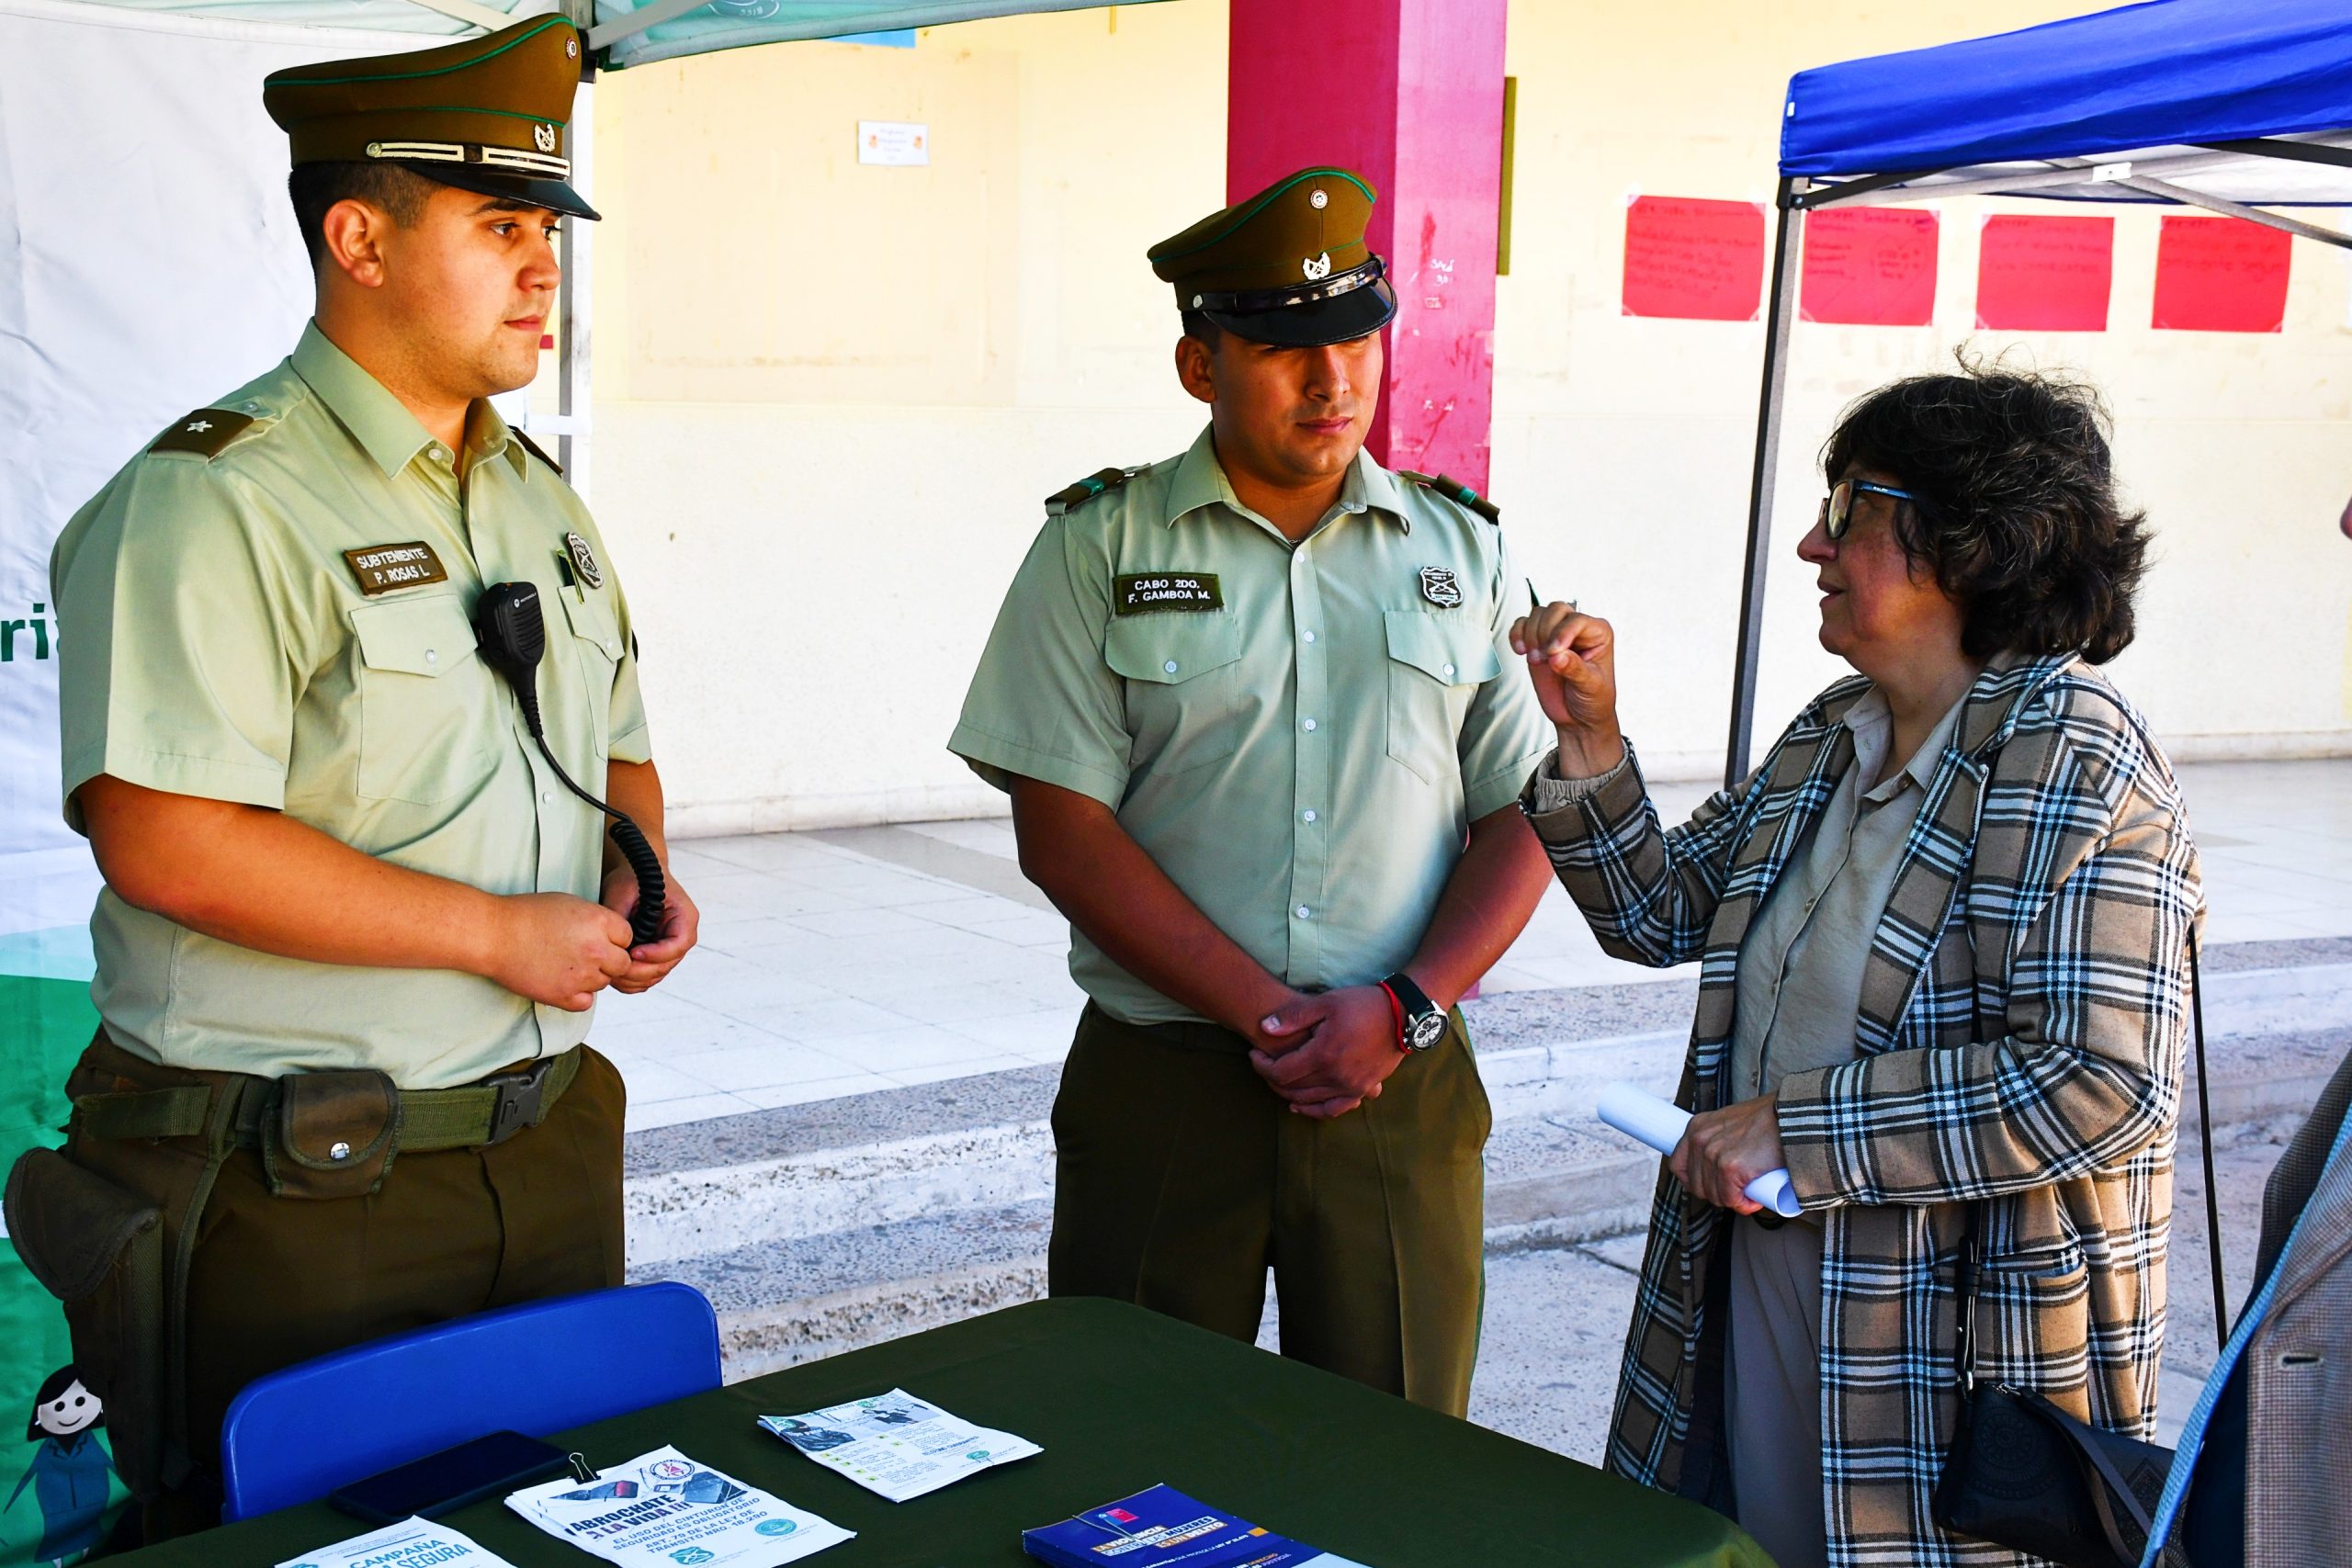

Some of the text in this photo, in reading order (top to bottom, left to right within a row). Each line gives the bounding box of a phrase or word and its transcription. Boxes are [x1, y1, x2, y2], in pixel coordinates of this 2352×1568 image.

[356, 548, 428, 569] SUBTENIENTE
[374, 572, 387, 584] P.
[386, 566, 419, 581] ROSAS
[1135, 579, 1200, 591] CABO 2DO.
[1128, 590, 1211, 604] F. GAMBOA M.
[0, 603, 59, 662] ri
[570, 1495, 676, 1531] ABROCHATE
[600, 1522, 629, 1535] LA
[623, 1508, 673, 1526] VIDA
[613, 1497, 760, 1550] SEGURIDAD ES OBLIGATORIO
[628, 1529, 651, 1540] USO
[652, 1522, 674, 1531] DEL
[730, 1496, 745, 1506] DE
[704, 1522, 718, 1530] LA
[718, 1515, 738, 1525] LEY
[740, 1508, 754, 1517] DE
[1106, 1525, 1167, 1547] VIOENCIA
[1165, 1517, 1212, 1536] MUJERES
[647, 1534, 704, 1553] TRANSITO
[1169, 1534, 1189, 1543] UN
[349, 1540, 447, 1568] CAMPAÑA
[396, 1543, 473, 1568] SEGURA
